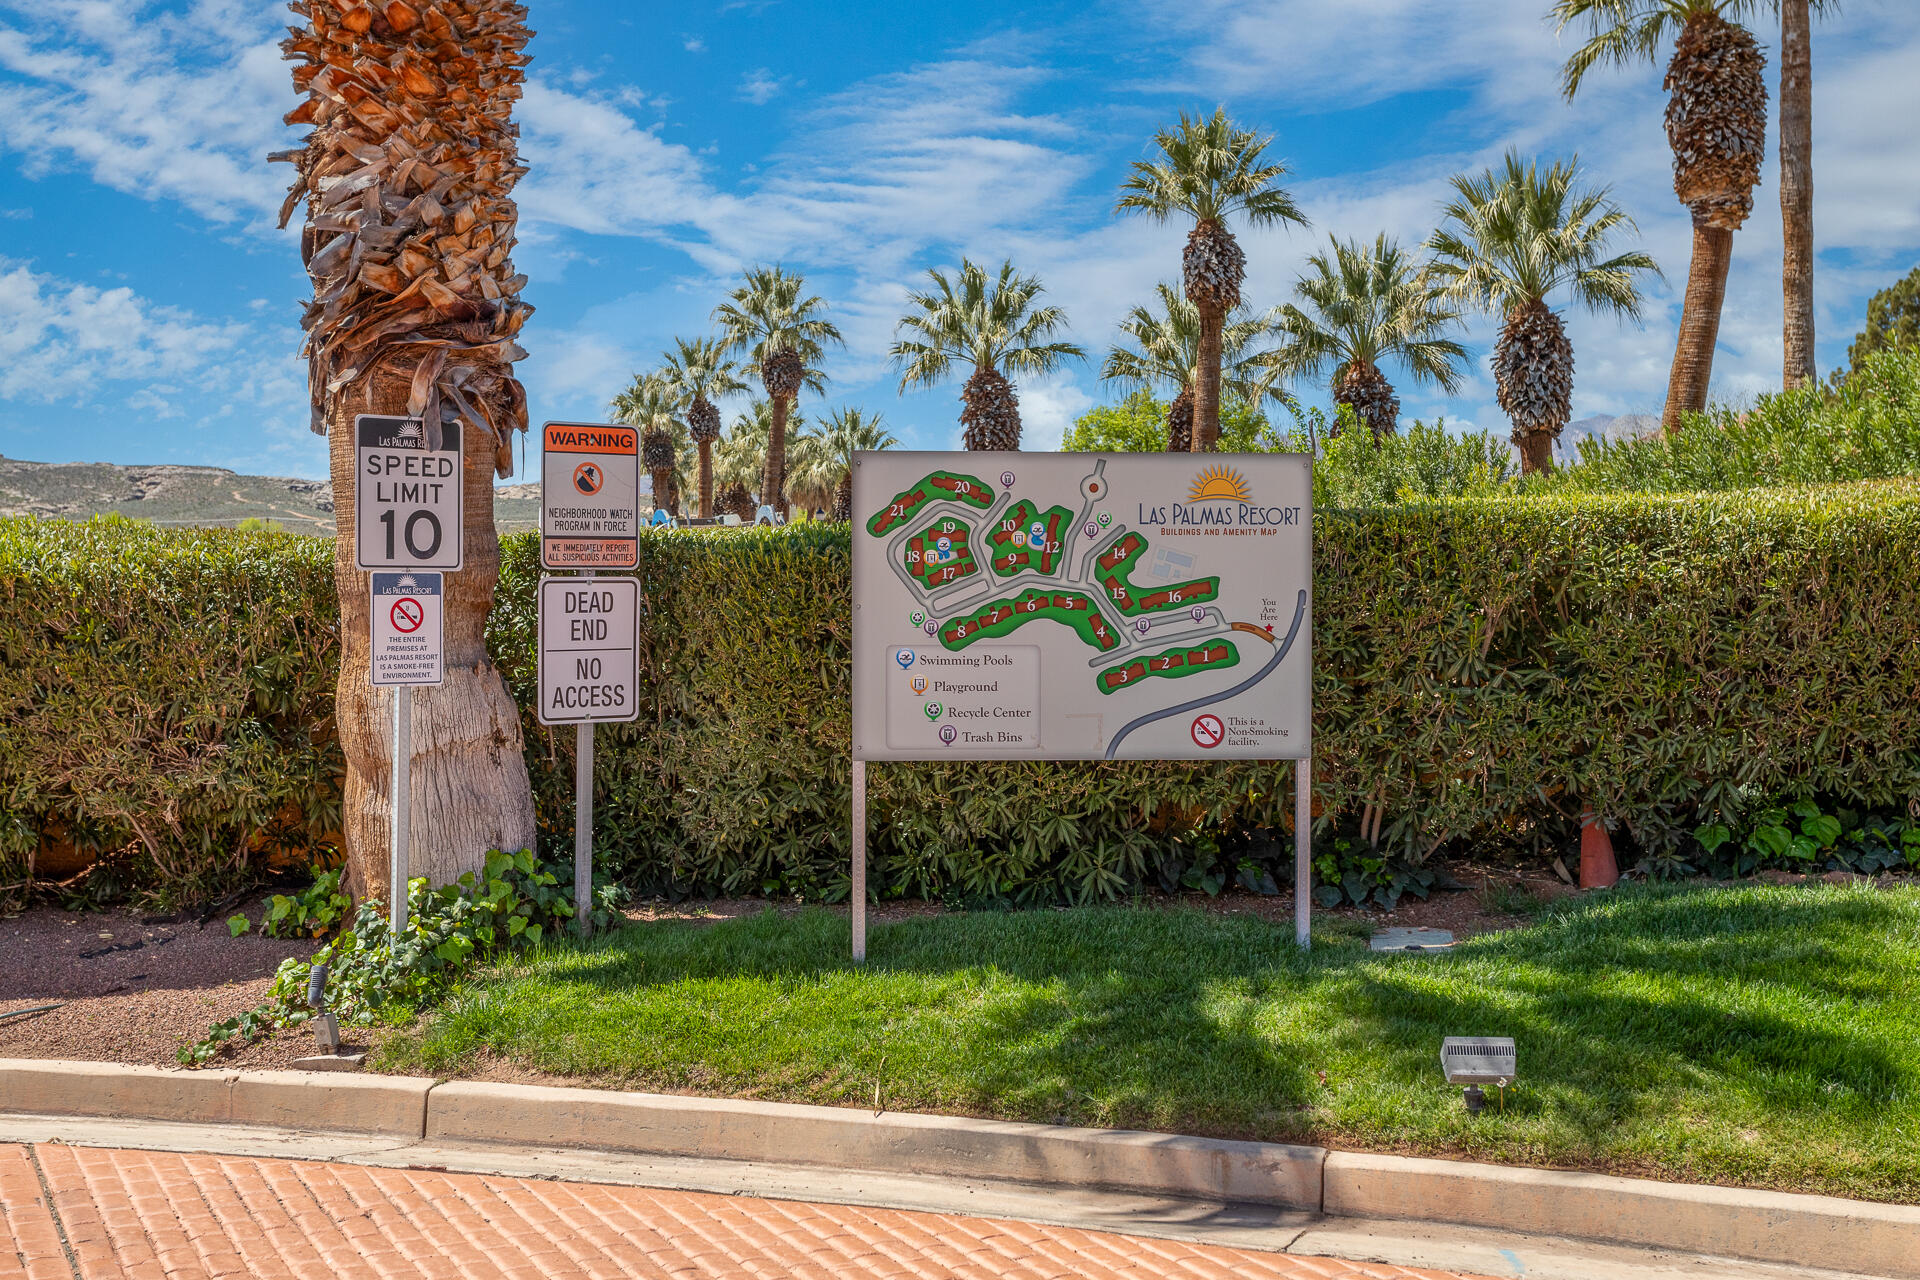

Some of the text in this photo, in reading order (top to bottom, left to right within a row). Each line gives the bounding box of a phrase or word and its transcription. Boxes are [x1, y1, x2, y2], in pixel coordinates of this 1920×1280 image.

[379, 436, 390, 446] LAS
[392, 437, 416, 448] PALMAS
[550, 432, 633, 448] WARNING
[367, 454, 453, 478] SPEED
[377, 482, 443, 504] LIMIT
[954, 481, 970, 493] 20
[549, 508, 633, 519] NEIGHBORHOOD WATCH
[891, 505, 905, 517] 21
[1139, 503, 1300, 525] LAS PALMAS RESORT
[554, 521, 627, 531] PROGRAM IN FORCE
[942, 522, 956, 534] 19
[1002, 520, 1016, 531] 10
[380, 510, 442, 560] 10
[1161, 528, 1201, 536] BUILDINGS
[1223, 528, 1257, 536] AMENITY
[1046, 542, 1059, 553] 12
[1113, 548, 1126, 559] 14
[907, 551, 920, 563] 18
[1008, 554, 1017, 565] 9
[942, 568, 955, 580] 17
[1113, 587, 1126, 599] 15
[1168, 590, 1181, 602] 16
[565, 592, 614, 613] DEAD
[1027, 599, 1035, 611] 6
[1066, 597, 1073, 608] 5
[991, 612, 999, 623] 7
[571, 620, 607, 641] END
[957, 626, 966, 637] 8
[1097, 626, 1105, 637] 4
[920, 655, 1013, 667] Swimming Pools
[1203, 650, 1209, 662] 1
[577, 658, 601, 680] NO
[1162, 657, 1170, 669] 2
[1120, 671, 1127, 682] 3
[934, 681, 998, 694] Playground
[552, 685, 624, 708] ACCESS
[948, 707, 1031, 719] Recycle Center
[1228, 717, 1247, 725] This
[962, 732, 1022, 742] Trash Bins
[1228, 727, 1288, 736] Non-Smoking
[1228, 737, 1260, 746] facility.
